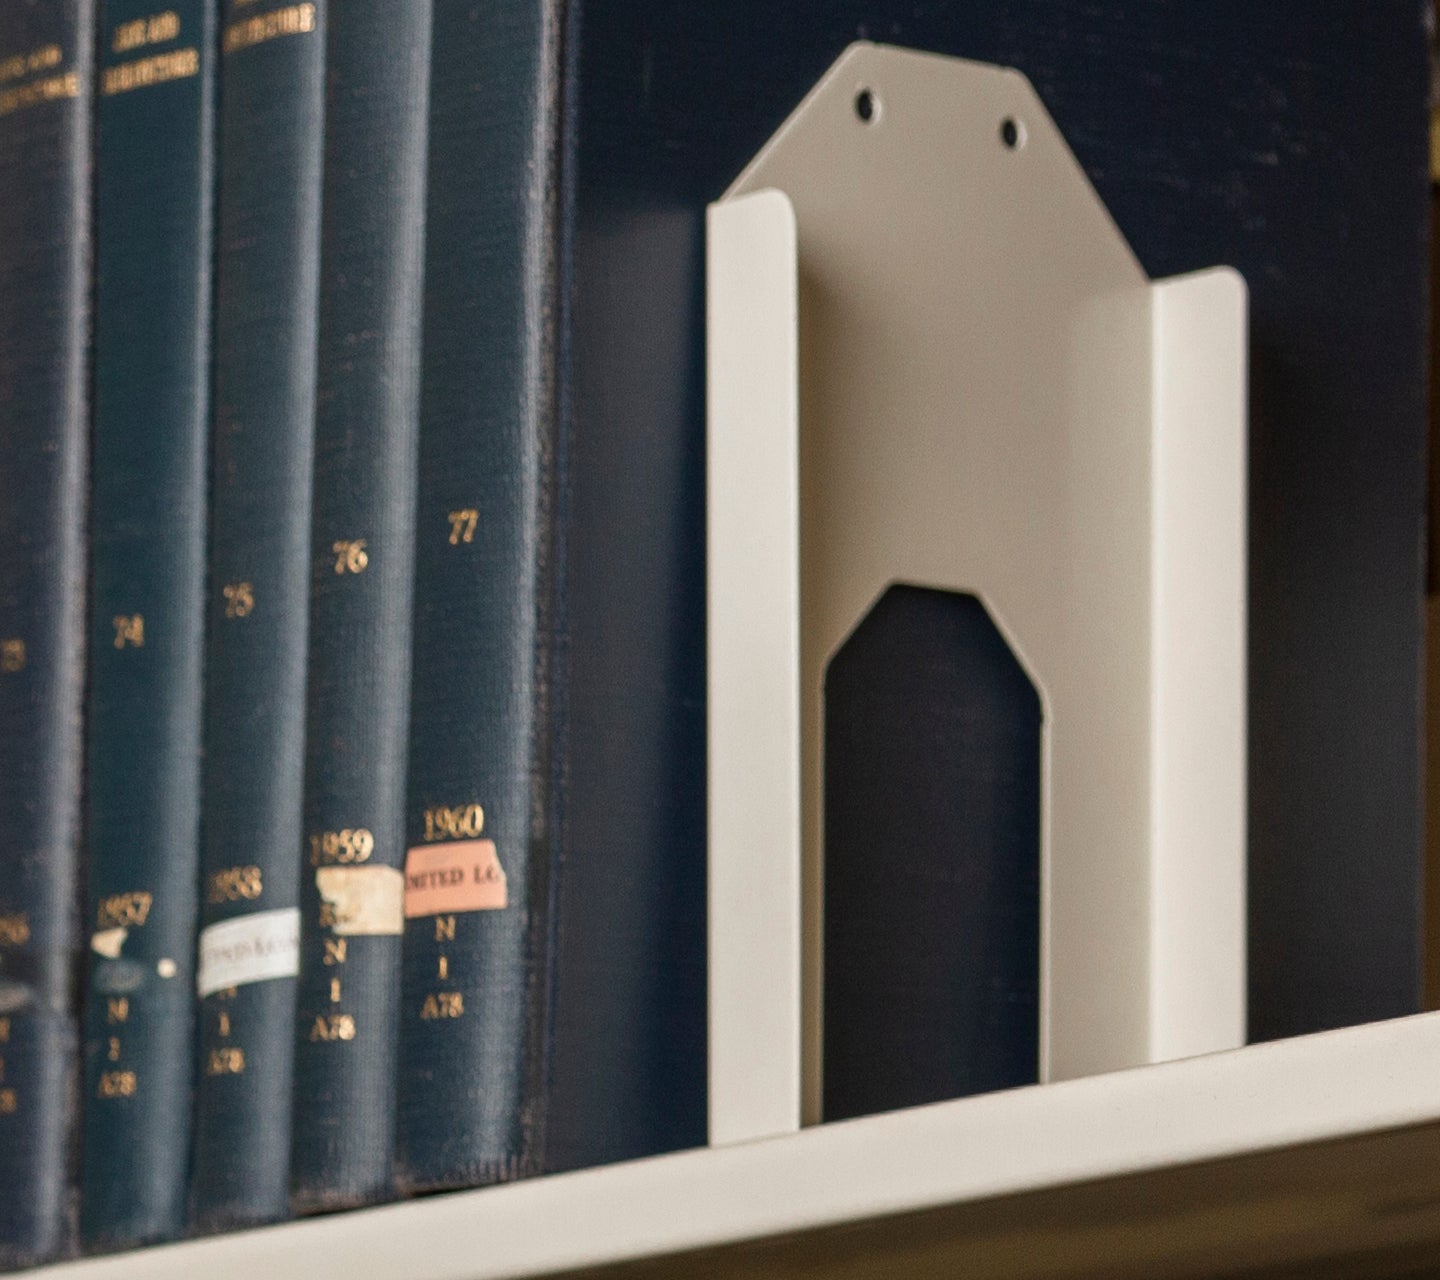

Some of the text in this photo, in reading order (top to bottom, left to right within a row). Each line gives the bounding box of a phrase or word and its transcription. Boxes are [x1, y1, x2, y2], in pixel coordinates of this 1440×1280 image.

[447, 508, 479, 545] 77
[332, 537, 369, 576] 76
[223, 580, 255, 619] 75
[423, 803, 484, 841] 1960
[309, 827, 375, 867] 1959
[435, 915, 456, 942] N
[322, 938, 348, 966] N
[419, 991, 465, 1020] A78
[309, 1013, 357, 1043] A78
